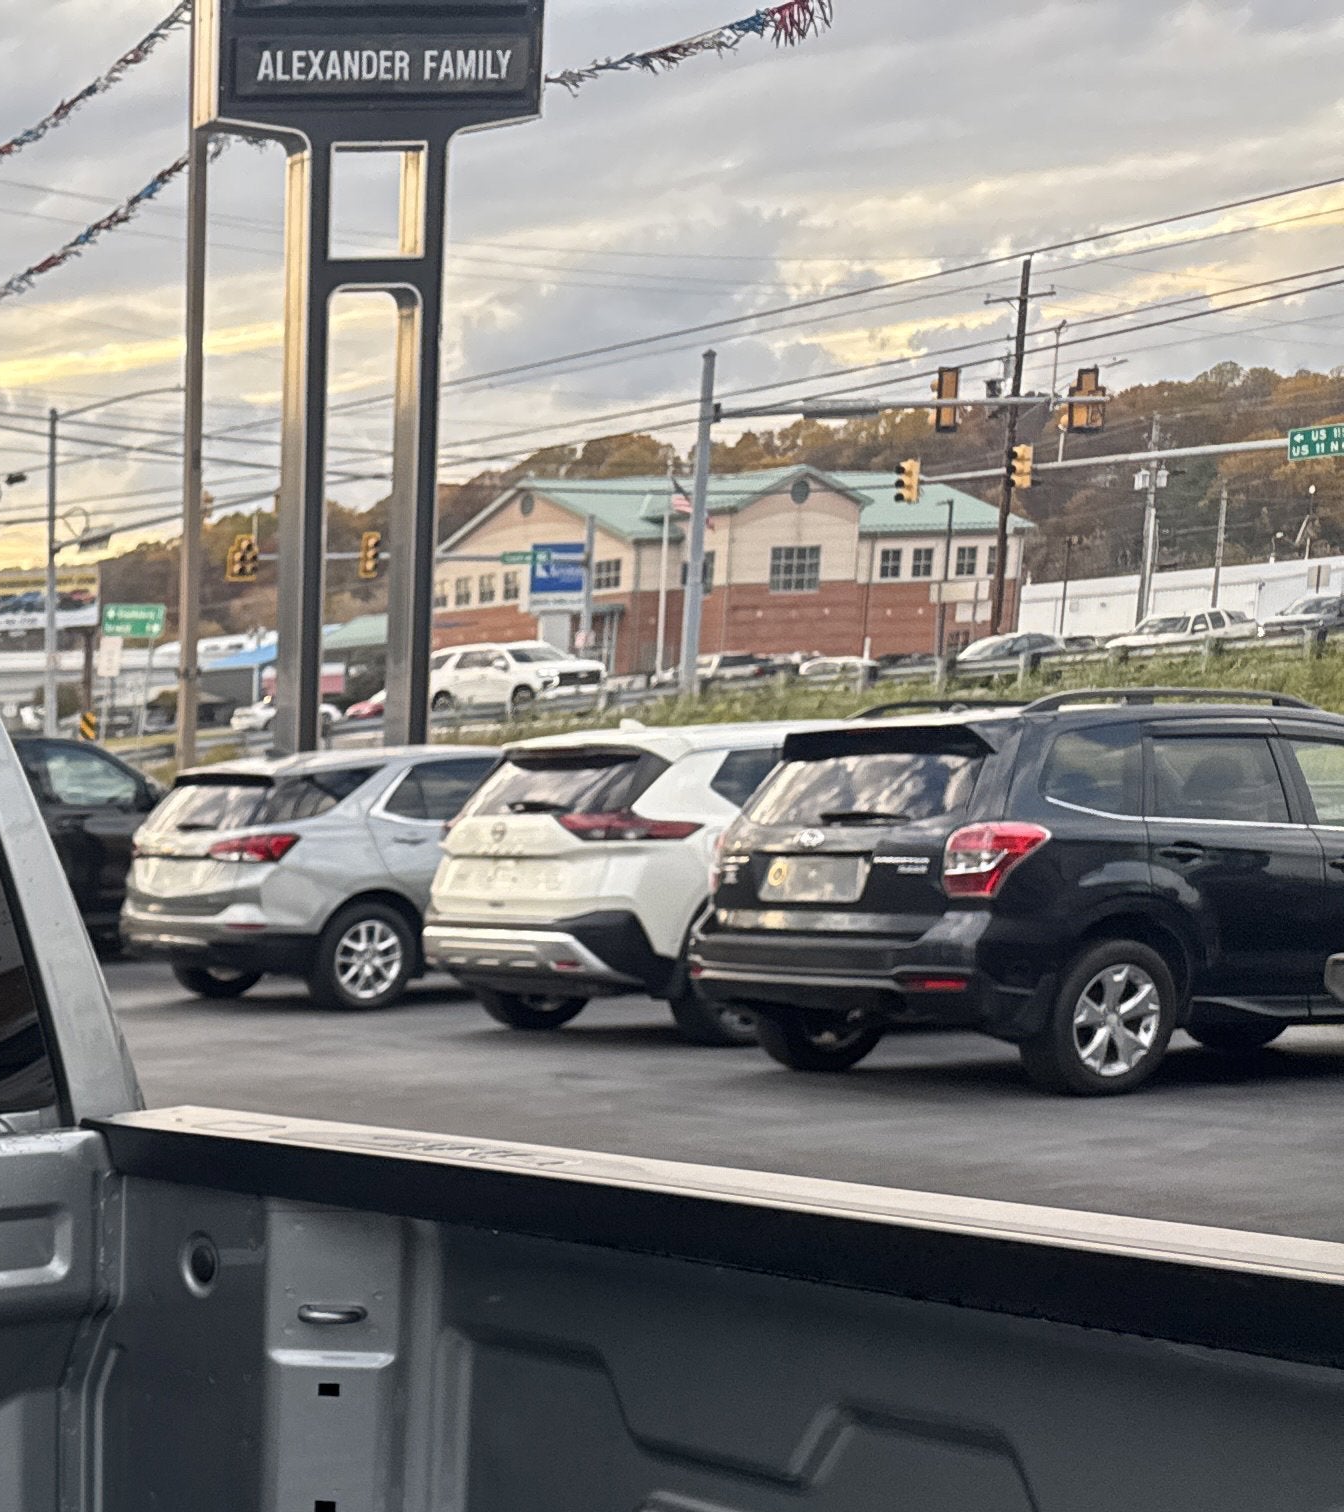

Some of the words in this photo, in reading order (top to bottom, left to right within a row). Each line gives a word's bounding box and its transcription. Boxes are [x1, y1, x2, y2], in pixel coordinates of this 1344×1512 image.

[257, 50, 410, 82] ALEXANDER
[423, 49, 512, 81] FAMILY
[1311, 429, 1327, 441] US
[1292, 444, 1310, 457] US
[1315, 442, 1325, 454] 11
[1330, 440, 1339, 452] N
